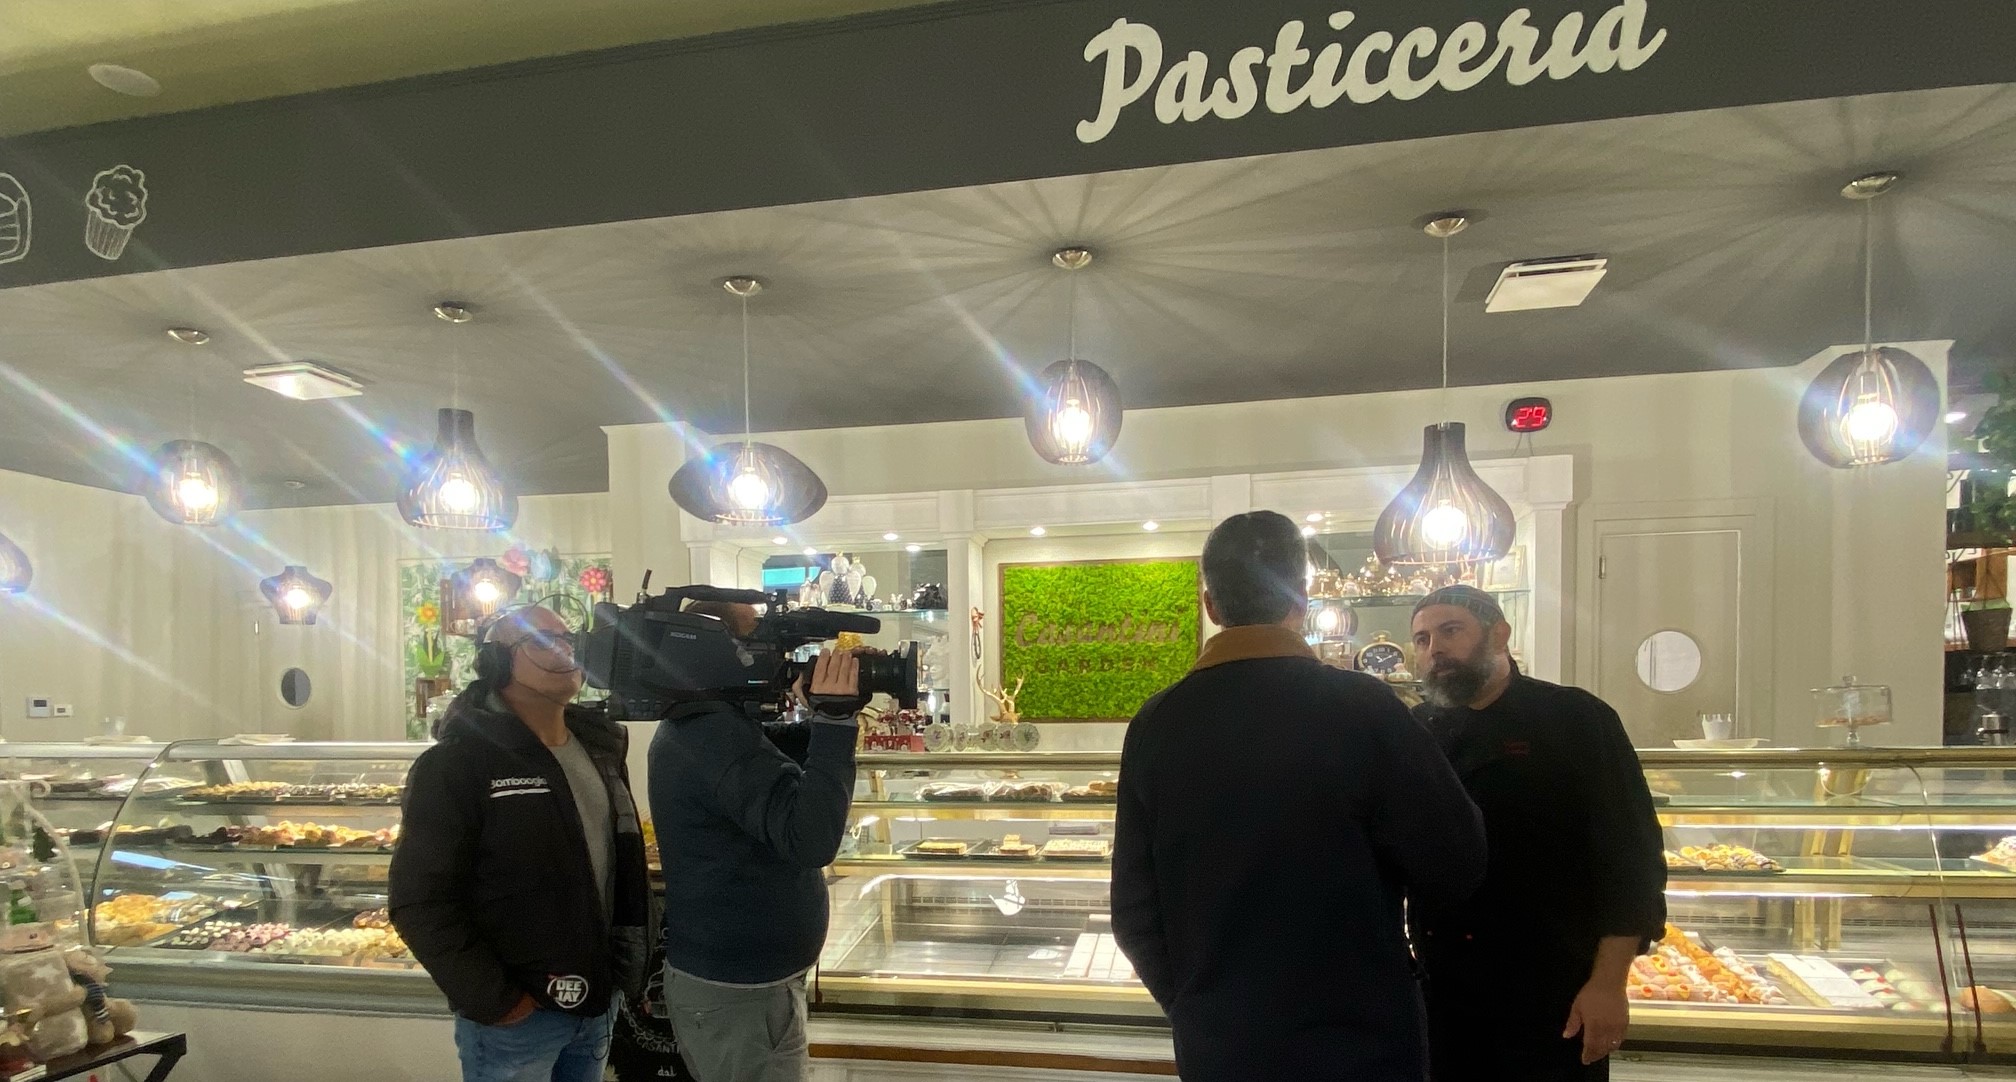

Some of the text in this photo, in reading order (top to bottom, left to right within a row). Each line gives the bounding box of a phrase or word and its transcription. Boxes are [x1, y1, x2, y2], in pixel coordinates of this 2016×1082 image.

[1075, 0, 1668, 144] Pasticceria
[1516, 406, 1547, 428] 29
[556, 979, 582, 991] DEE
[554, 991, 581, 1002] JAY
